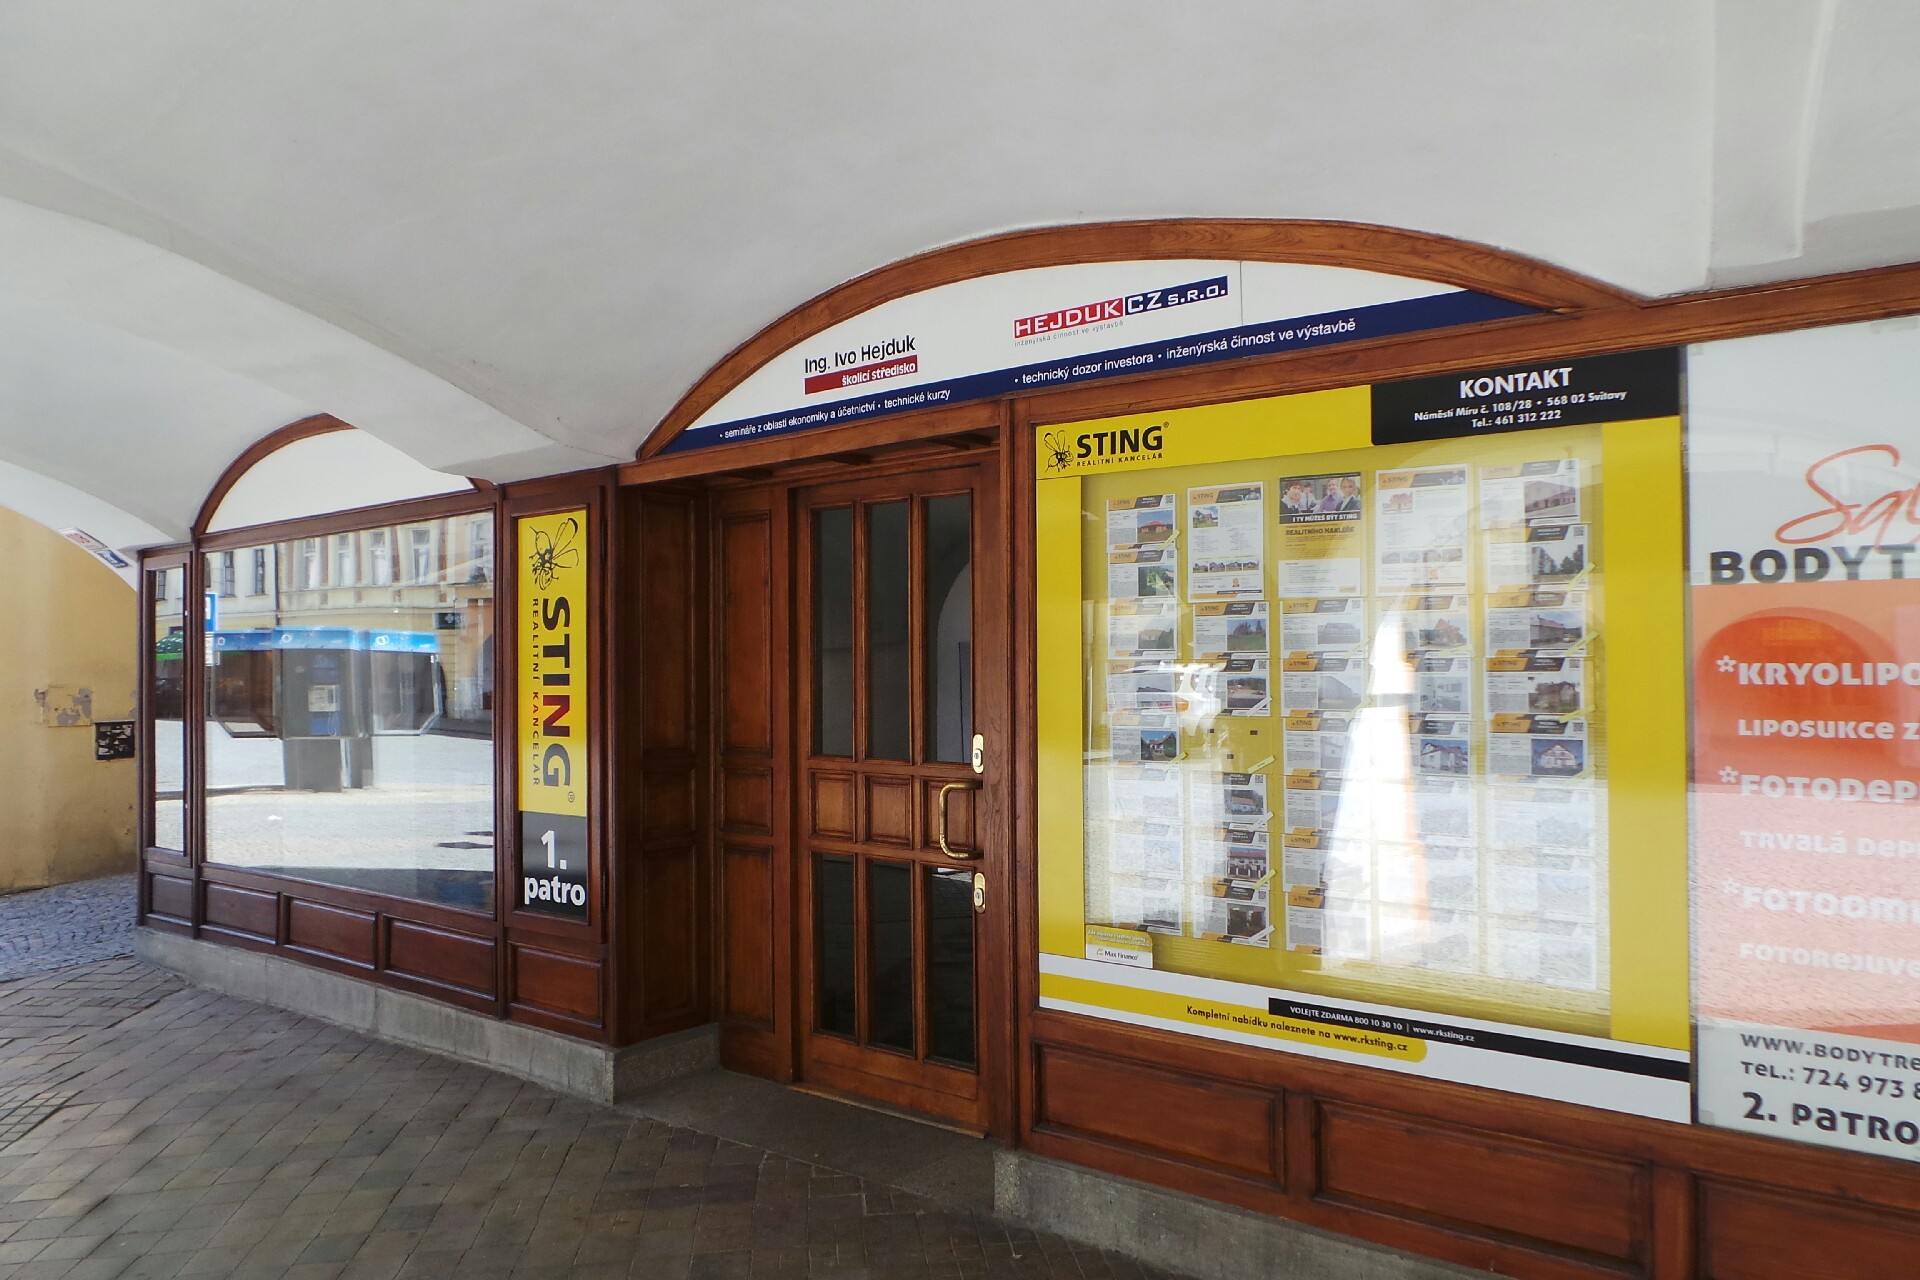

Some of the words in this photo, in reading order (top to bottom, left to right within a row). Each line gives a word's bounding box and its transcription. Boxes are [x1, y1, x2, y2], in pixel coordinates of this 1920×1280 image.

[1016, 299, 1120, 336] HEJDUK
[1127, 291, 1162, 313] CZ
[805, 356, 830, 373] Ing.
[835, 350, 856, 367] Ivo
[861, 335, 916, 361] Hejduk
[1022, 366, 1070, 384] technický
[1072, 361, 1102, 377] dozor
[1104, 352, 1154, 371] investora
[1166, 338, 1227, 360] inženýrská
[1230, 330, 1275, 348] činnost
[1278, 329, 1294, 341] ve
[1296, 318, 1356, 340] výstavbě
[871, 362, 916, 381] středisko
[1459, 367, 1573, 399] KONTAKT
[724, 424, 756, 438] semináře
[763, 418, 787, 431] oblasti
[788, 411, 829, 427] ekonomiky
[830, 411, 836, 419] a
[837, 401, 876, 417] účetnictví
[884, 392, 925, 409] technické
[926, 389, 951, 401] kurzy
[1414, 408, 1454, 421] Náměstí
[1455, 406, 1478, 417] Míru
[1480, 405, 1489, 414] č.
[1492, 400, 1532, 414] 108/28
[1546, 396, 1568, 406] 568
[1571, 393, 1586, 404] 02
[1588, 390, 1628, 401] Svitavy
[1471, 418, 1493, 428] Tel.:
[1494, 415, 1514, 426] 461
[1517, 412, 1537, 423] 312
[1540, 410, 1562, 421] 222
[1077, 425, 1163, 459] STING
[1709, 543, 1916, 585] BODYT
[542, 596, 571, 787] STING
[1738, 662, 1920, 686] KRYOLIPO
[541, 830, 567, 870] 1.
[524, 875, 586, 906] patro
[1187, 1005, 1230, 1021] Kompletní
[1232, 1015, 1268, 1028] nabídku
[1270, 1021, 1316, 1036] naleznete
[1318, 1030, 1331, 1039] na
[1334, 1032, 1408, 1051] www.rksting.cz
[1290, 1005, 1320, 1018] VOLEJTE
[1320, 1011, 1354, 1023] ZDARMA
[1354, 1016, 1369, 1026] 800
[1371, 1019, 1380, 1028] 10
[1381, 1020, 1391, 1029] 30
[1393, 1022, 1403, 1031] 10
[1413, 1026, 1475, 1042] www.rksting.cz
[1802, 1067, 1849, 1090] 724
[1858, 1075, 1905, 1099] 973
[1742, 1091, 1777, 1122] 2.
